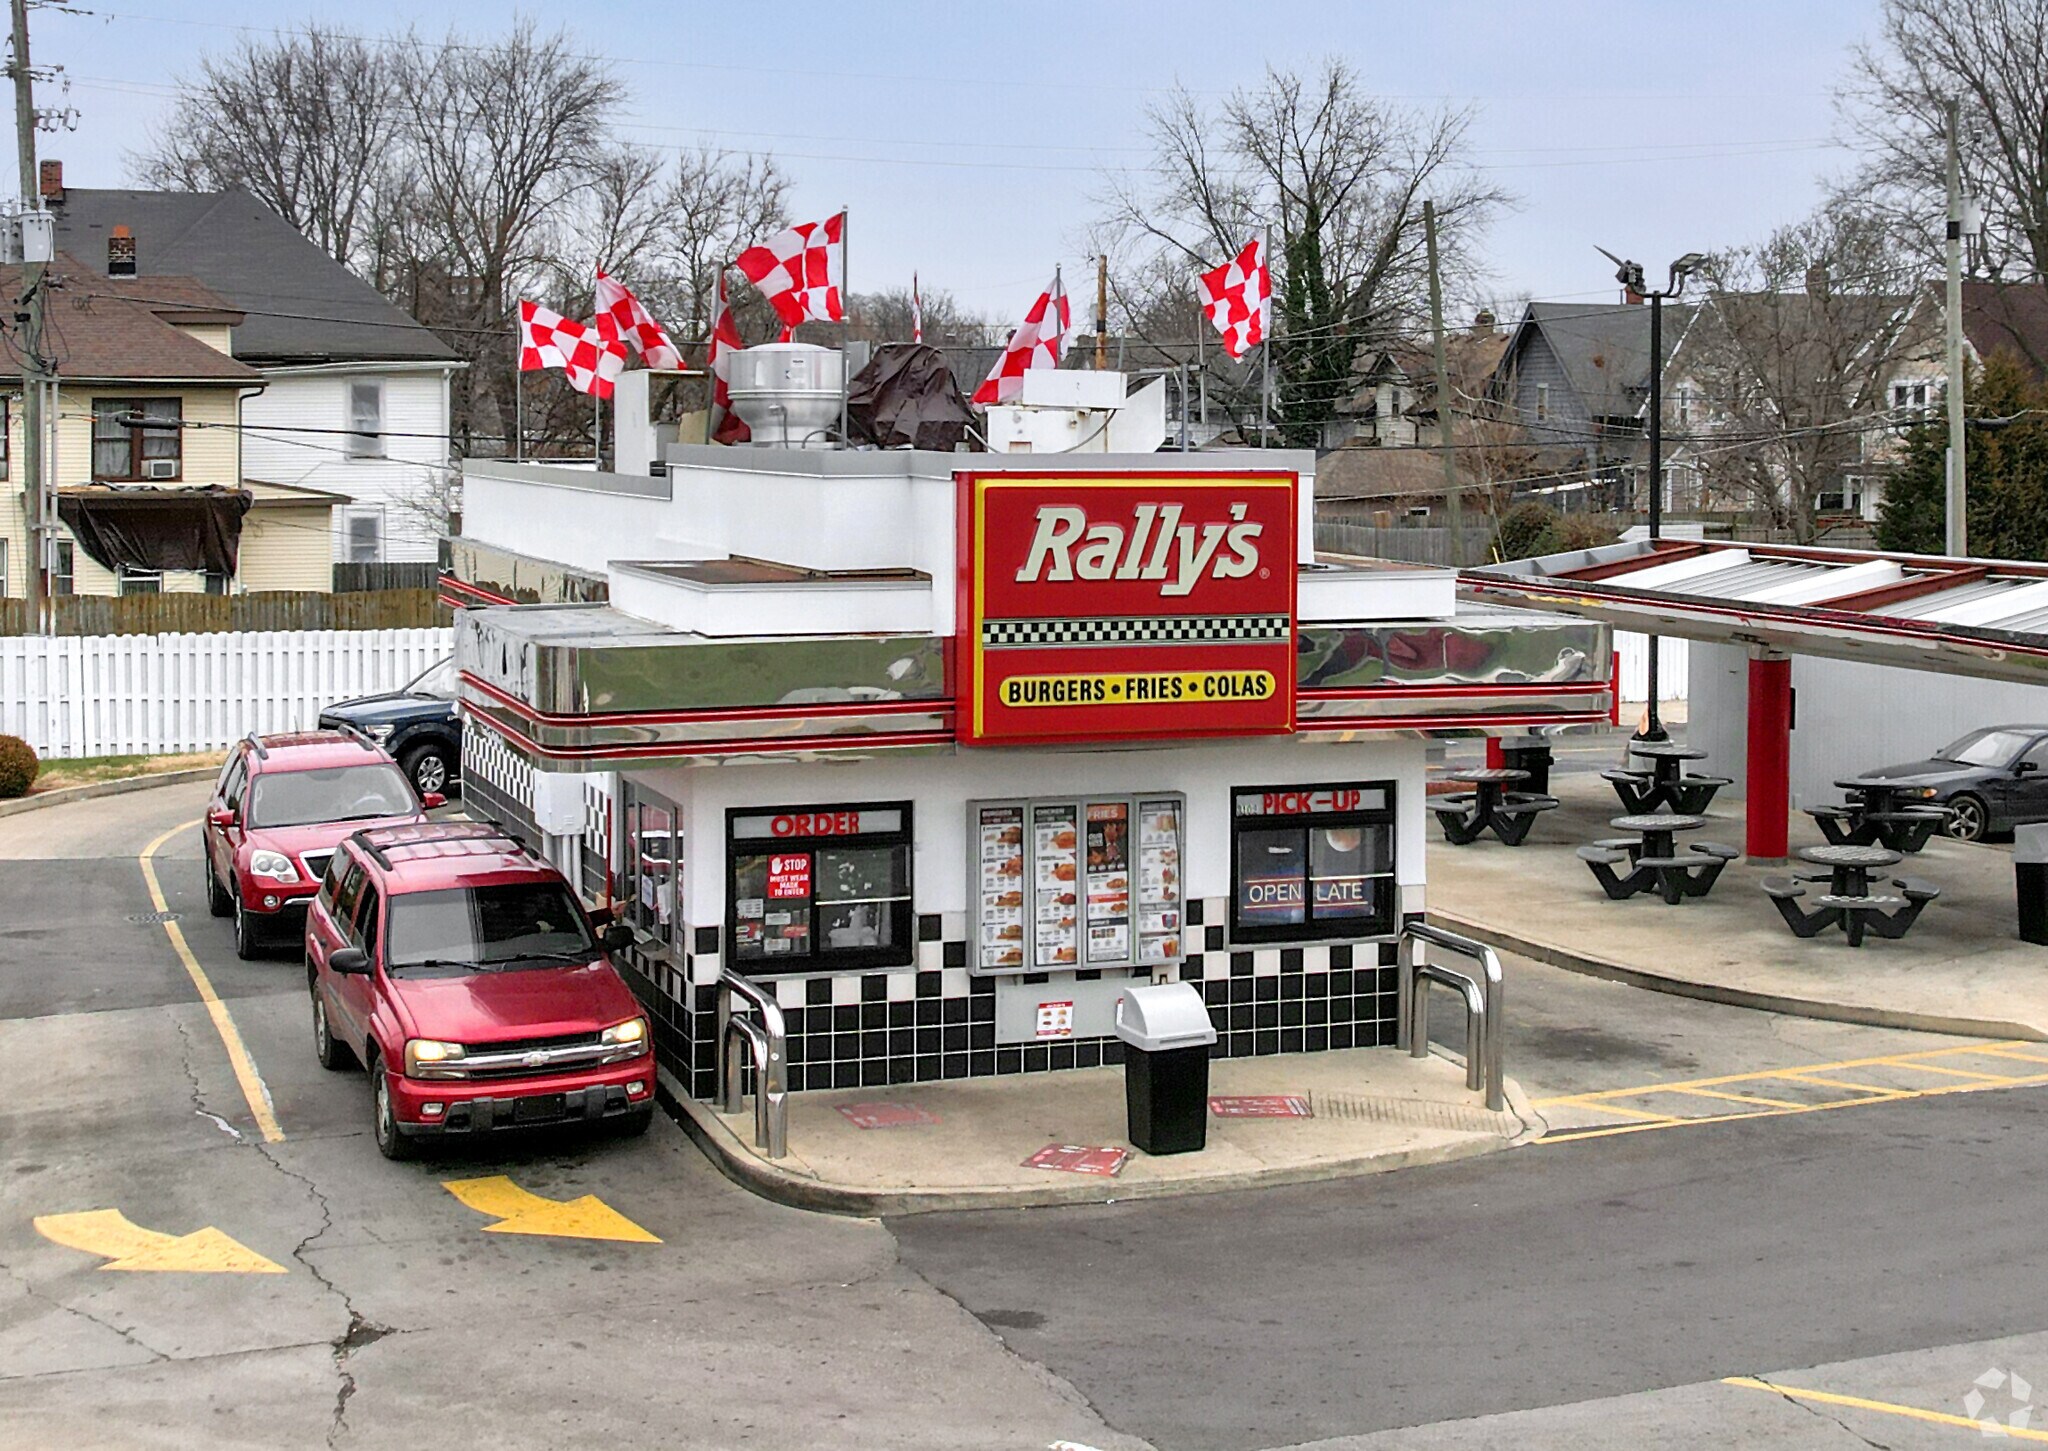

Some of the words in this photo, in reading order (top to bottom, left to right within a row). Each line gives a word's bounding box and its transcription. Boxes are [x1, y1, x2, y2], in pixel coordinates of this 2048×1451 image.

[1015, 502, 1263, 596] Rally's
[1009, 679, 1106, 702] BURGERS
[1126, 677, 1183, 700] FRIES
[1203, 675, 1267, 697] COLAS
[1263, 789, 1360, 814] PICK-UP
[771, 811, 859, 838] ORDER
[784, 858, 807, 871] STOP
[1249, 883, 1302, 903] OPEN
[1316, 882, 1363, 901] LATE
